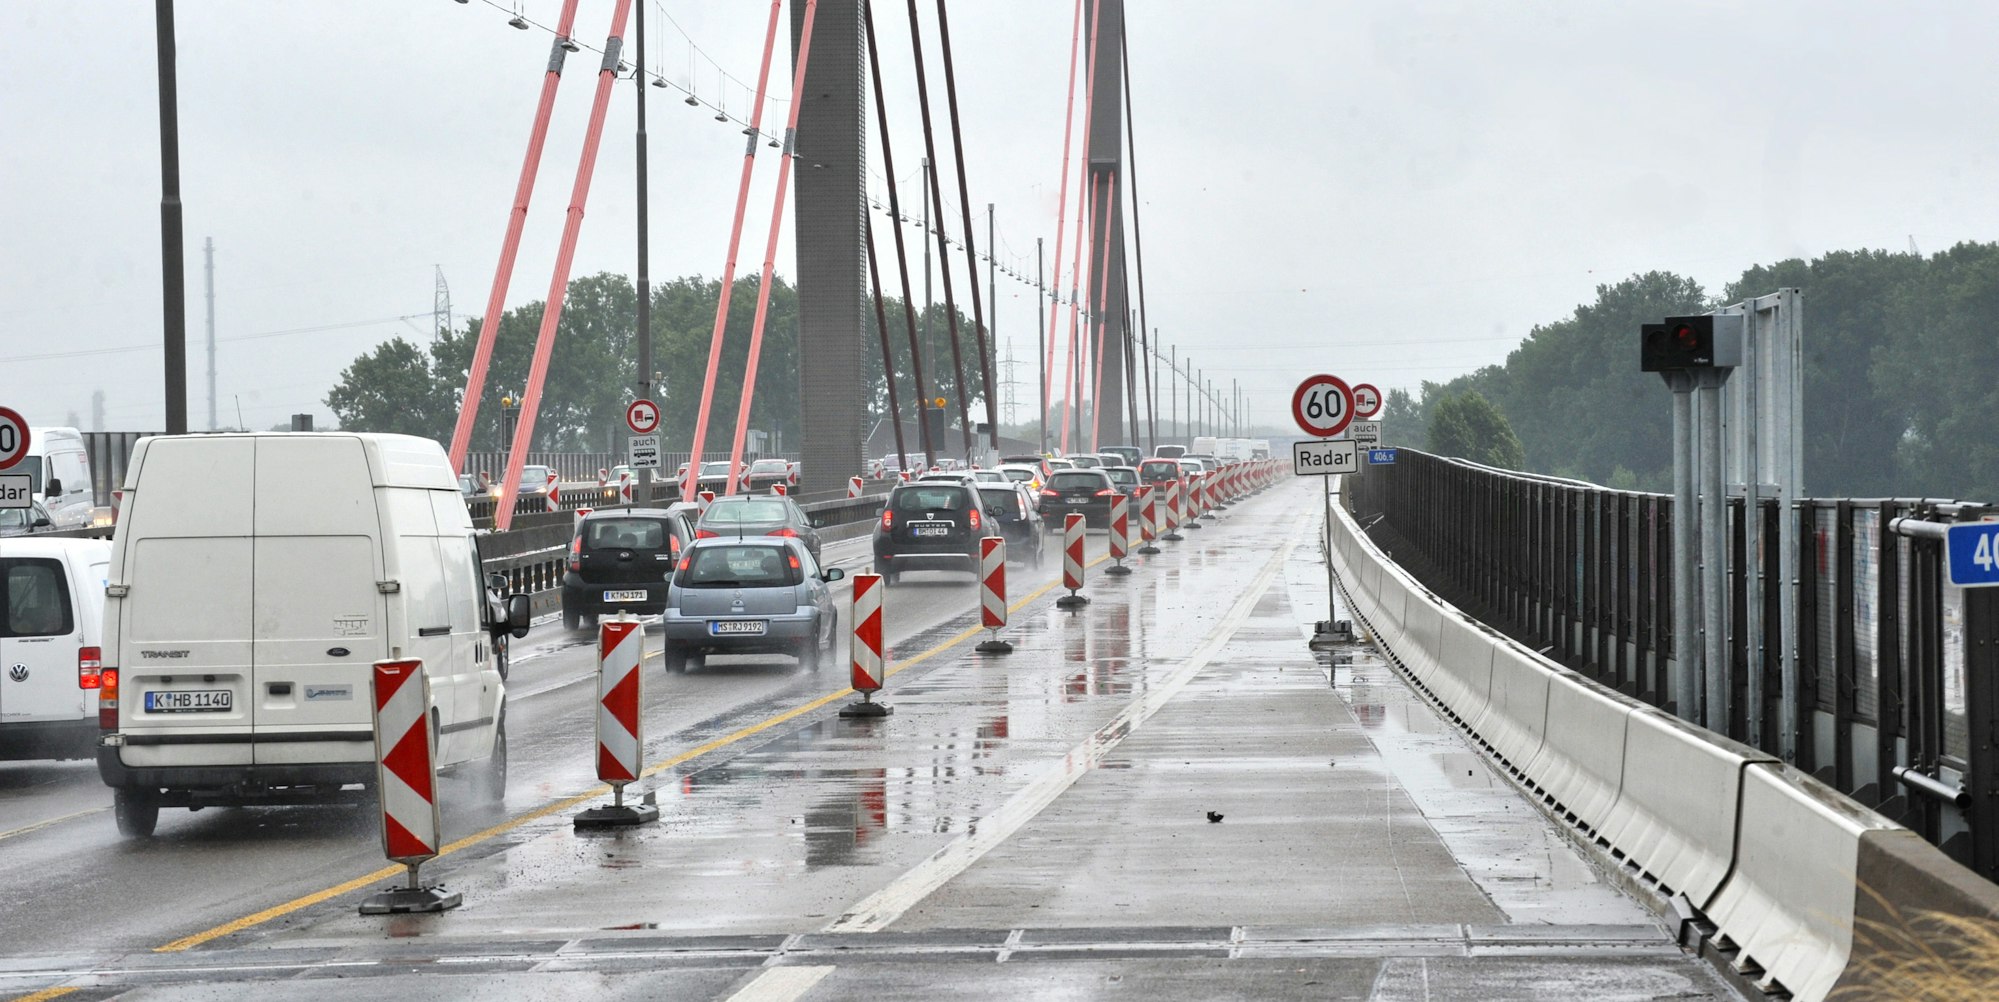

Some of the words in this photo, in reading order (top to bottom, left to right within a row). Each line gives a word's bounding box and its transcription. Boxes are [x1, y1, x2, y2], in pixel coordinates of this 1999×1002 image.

[1307, 390, 1341, 418] 60
[1354, 424, 1377, 432] auch
[633, 437, 655, 446] auch
[1300, 450, 1352, 467] Radar
[631, 591, 643, 599] 171
[744, 622, 761, 631] 9192
[141, 650, 190, 658] TRANSIT
[155, 694, 164, 707] K
[174, 693, 191, 707] HB
[195, 692, 229, 707] 1140
